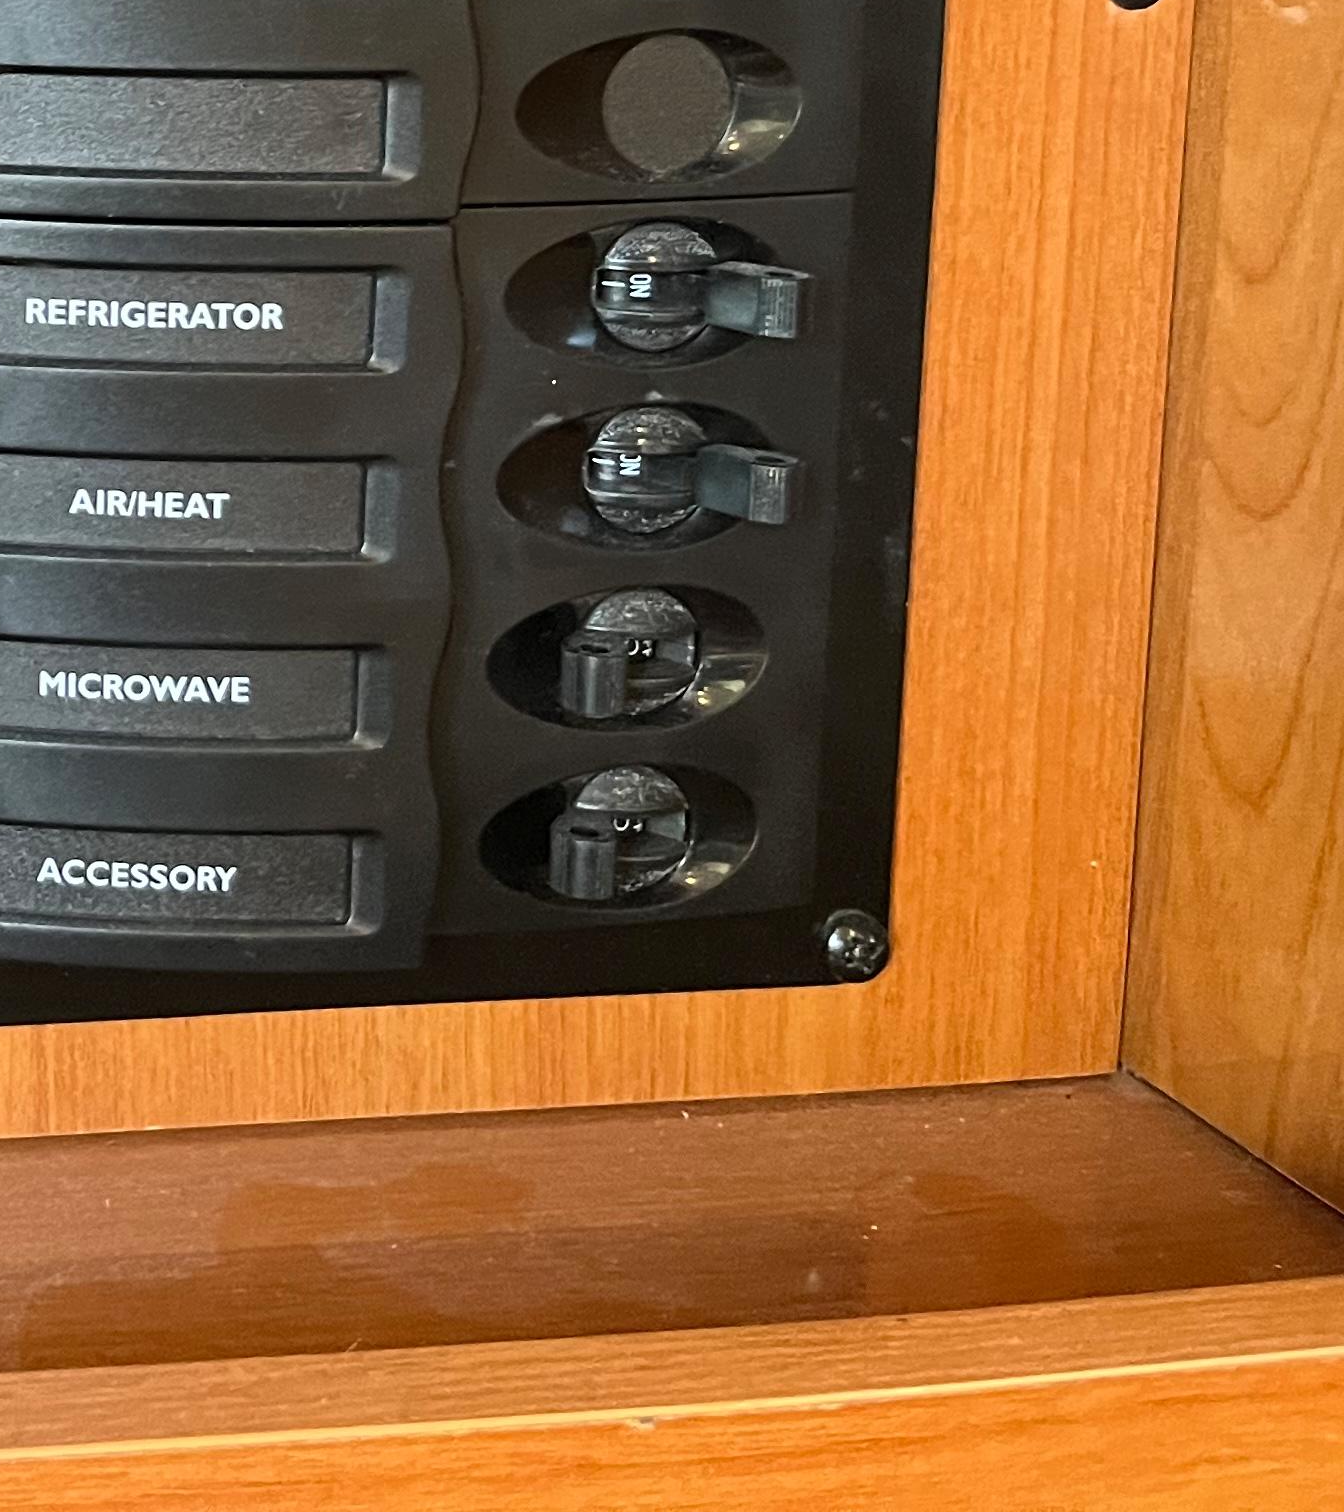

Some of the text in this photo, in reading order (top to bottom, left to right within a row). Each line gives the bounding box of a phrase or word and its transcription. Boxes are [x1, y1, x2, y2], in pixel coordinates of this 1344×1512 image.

[25, 297, 284, 331] REFRIGERATOR
[68, 488, 231, 520] AIR/HEAT
[39, 670, 250, 703] MICROWAVE
[36, 857, 238, 892] ACCESSORY
